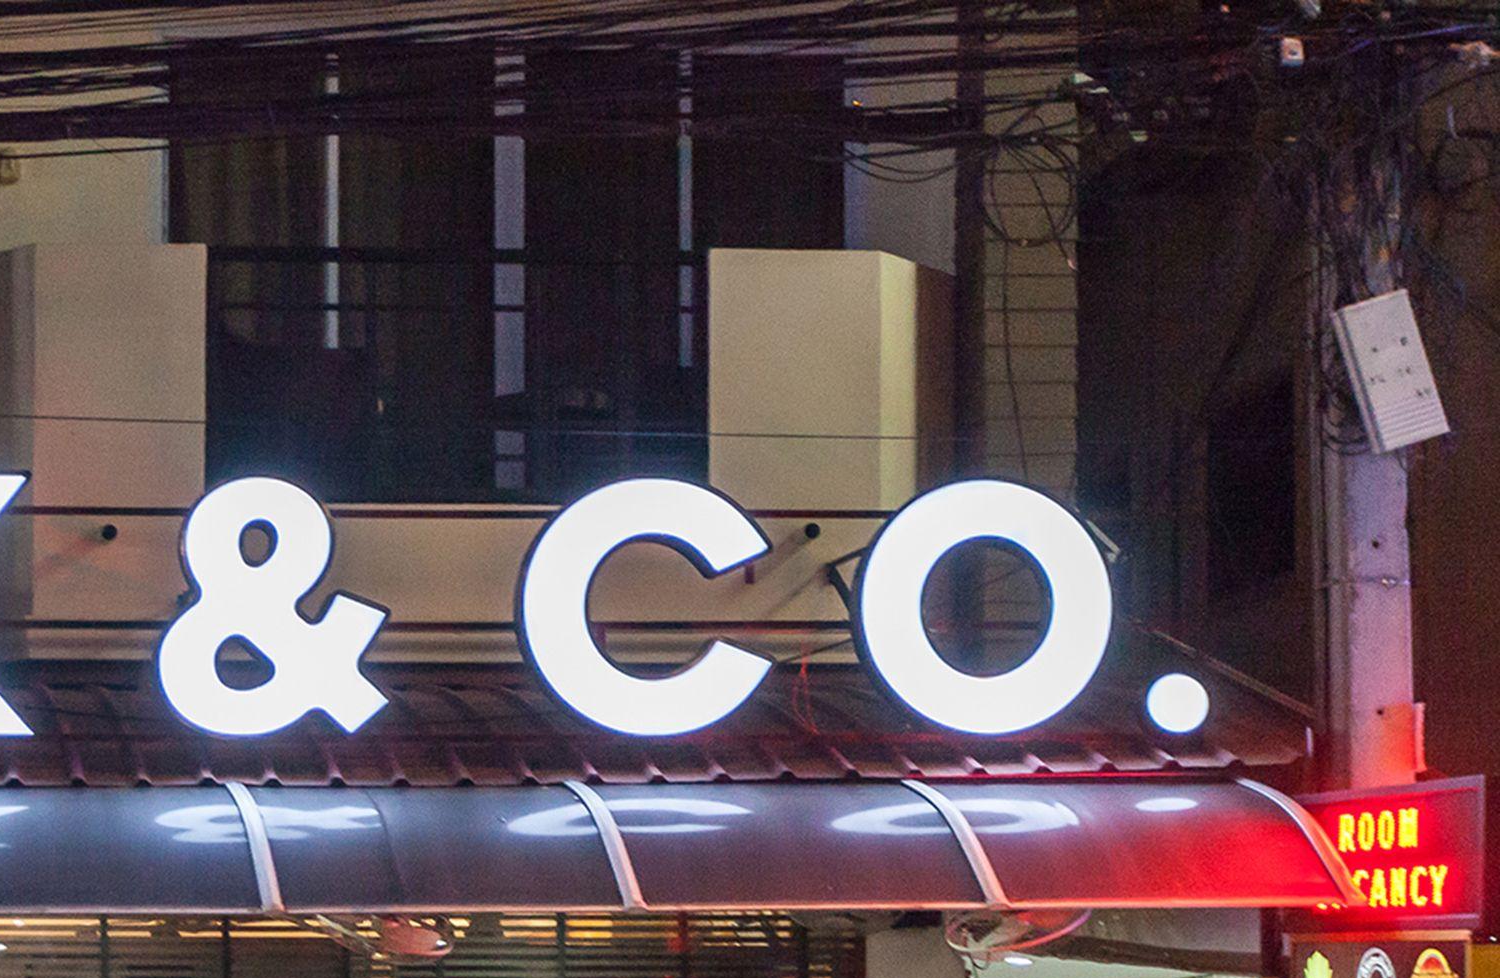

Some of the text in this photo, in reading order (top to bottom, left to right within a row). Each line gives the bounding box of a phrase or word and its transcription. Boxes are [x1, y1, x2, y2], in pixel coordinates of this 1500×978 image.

[156, 476, 390, 737] &
[521, 477, 1210, 737] CO.
[1338, 807, 1419, 853] ROOM
[1350, 864, 1449, 908] CANCY
